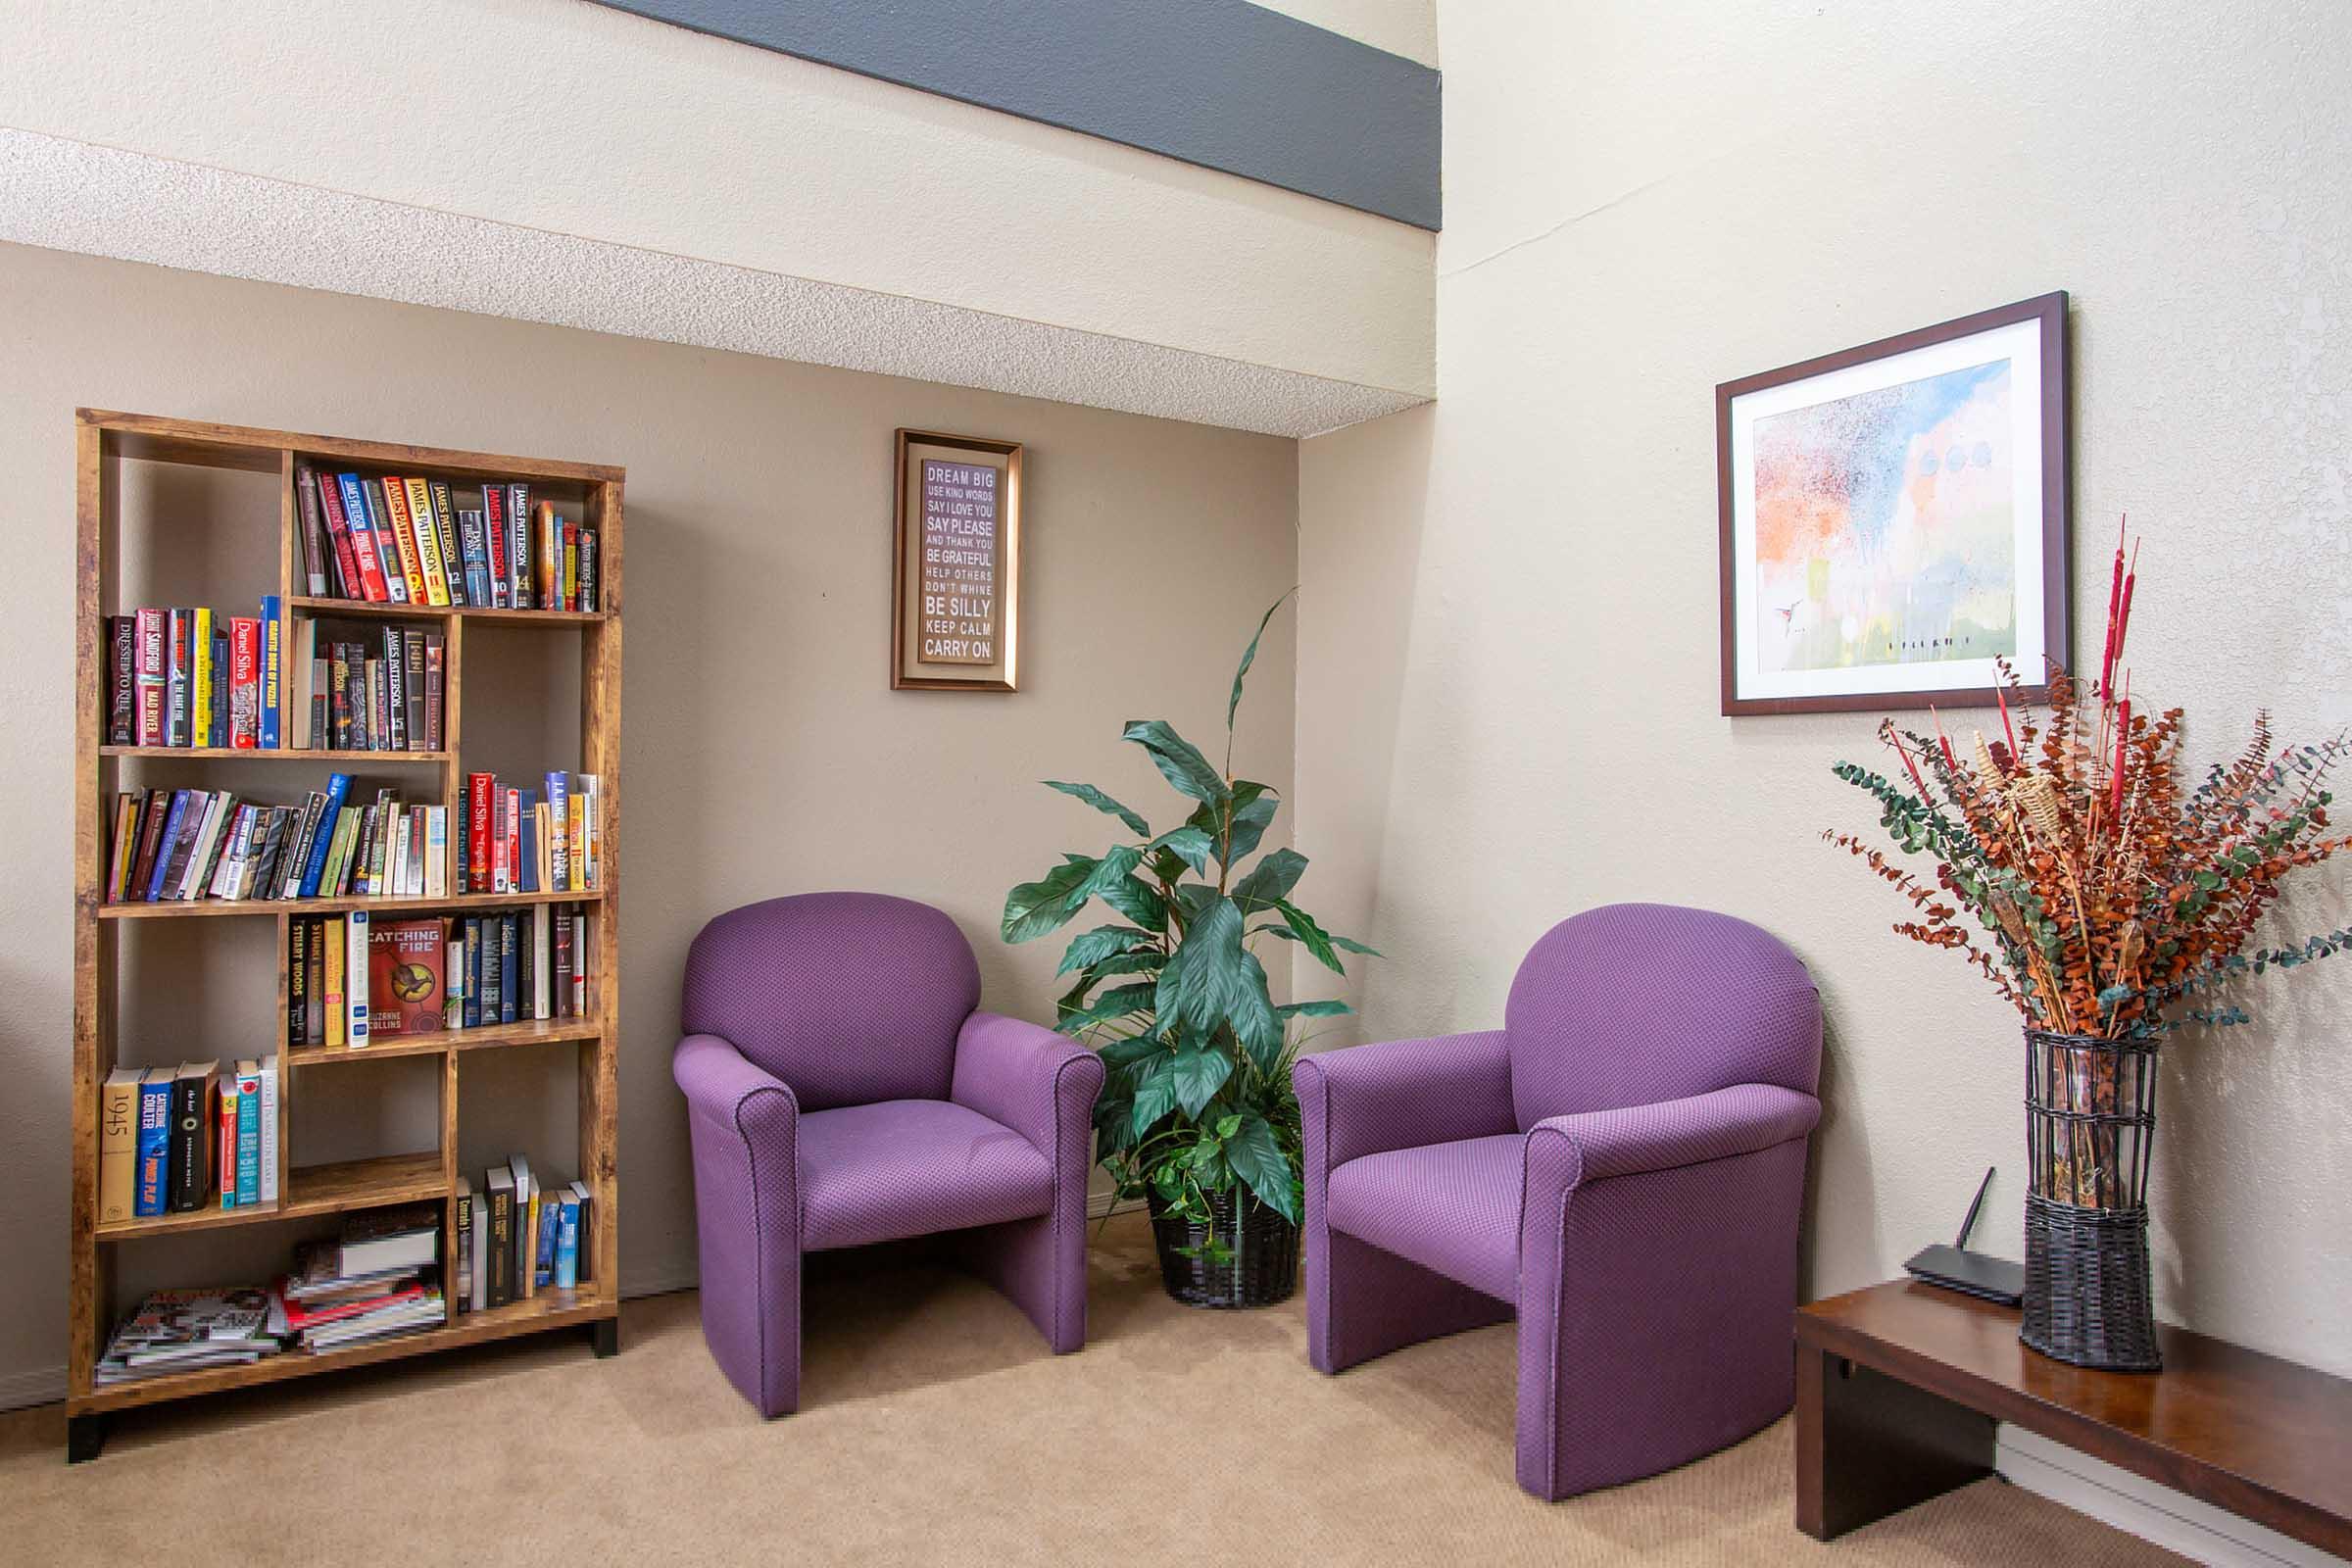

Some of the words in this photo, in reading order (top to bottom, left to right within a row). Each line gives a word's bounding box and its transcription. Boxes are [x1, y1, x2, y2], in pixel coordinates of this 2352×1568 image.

[928, 466, 969, 485] DREAM
[973, 472, 993, 488] BIG
[387, 482, 405, 514] JAMES
[412, 482, 427, 516] JAMES
[433, 485, 449, 514] JAMES
[488, 489, 502, 520] JAMES
[514, 489, 526, 518] JAMES
[928, 485, 945, 496] USE
[945, 487, 964, 499] KIND
[965, 489, 993, 502] WORDS
[927, 500, 945, 513] SAY
[951, 502, 973, 515] LOVE
[974, 504, 993, 517] YOU
[439, 513, 456, 564] PATTERSON
[927, 515, 950, 533] SAY
[951, 518, 993, 536] PLEASE
[394, 514, 416, 573] PATTERSON
[418, 516, 439, 573] PATTERSON
[464, 523, 476, 558] BROWN
[491, 521, 506, 579] PATTERSON
[516, 517, 527, 566] PATTERSON
[925, 534, 944, 545] AND
[946, 536, 974, 548] THANK
[975, 539, 993, 550] YOU
[926, 548, 941, 563] BE
[942, 550, 992, 566] GRATEFUL
[493, 582, 507, 593] 10
[925, 566, 951, 578] HELP
[955, 569, 993, 581] OTHERS
[925, 581, 957, 593] DON'T
[960, 583, 993, 596] WHINE
[146, 612, 161, 631] JOHN
[925, 596, 946, 615] BE
[950, 596, 991, 618] SILLY
[237, 621, 251, 654] Daniel
[925, 618, 956, 634] KEEP
[959, 621, 991, 636] CALM
[117, 623, 131, 672] DRESSED
[145, 632, 161, 672] SANDFORD
[390, 631, 400, 660] JAMES
[925, 639, 969, 657] CARRY
[972, 641, 990, 658] ON
[236, 655, 251, 680] Silva
[391, 659, 401, 707] PATTERSON
[115, 689, 131, 713] KILL
[146, 691, 159, 708] MAD
[146, 709, 159, 733] RIVER
[475, 777, 486, 808] Daniel
[475, 808, 486, 831] Silva
[554, 798, 565, 822] JANCE
[293, 924, 303, 959] STUART
[312, 924, 322, 961] STUART
[368, 930, 440, 943] CATCHING
[399, 941, 434, 953] FIRE
[293, 961, 303, 997] WOODS
[312, 964, 321, 1003] WOODS
[368, 1020, 401, 1029] COLLINS
[106, 1094, 129, 1137] 1945
[142, 1094, 156, 1130] COULTER
[155, 1093, 167, 1128] CATHERINE
